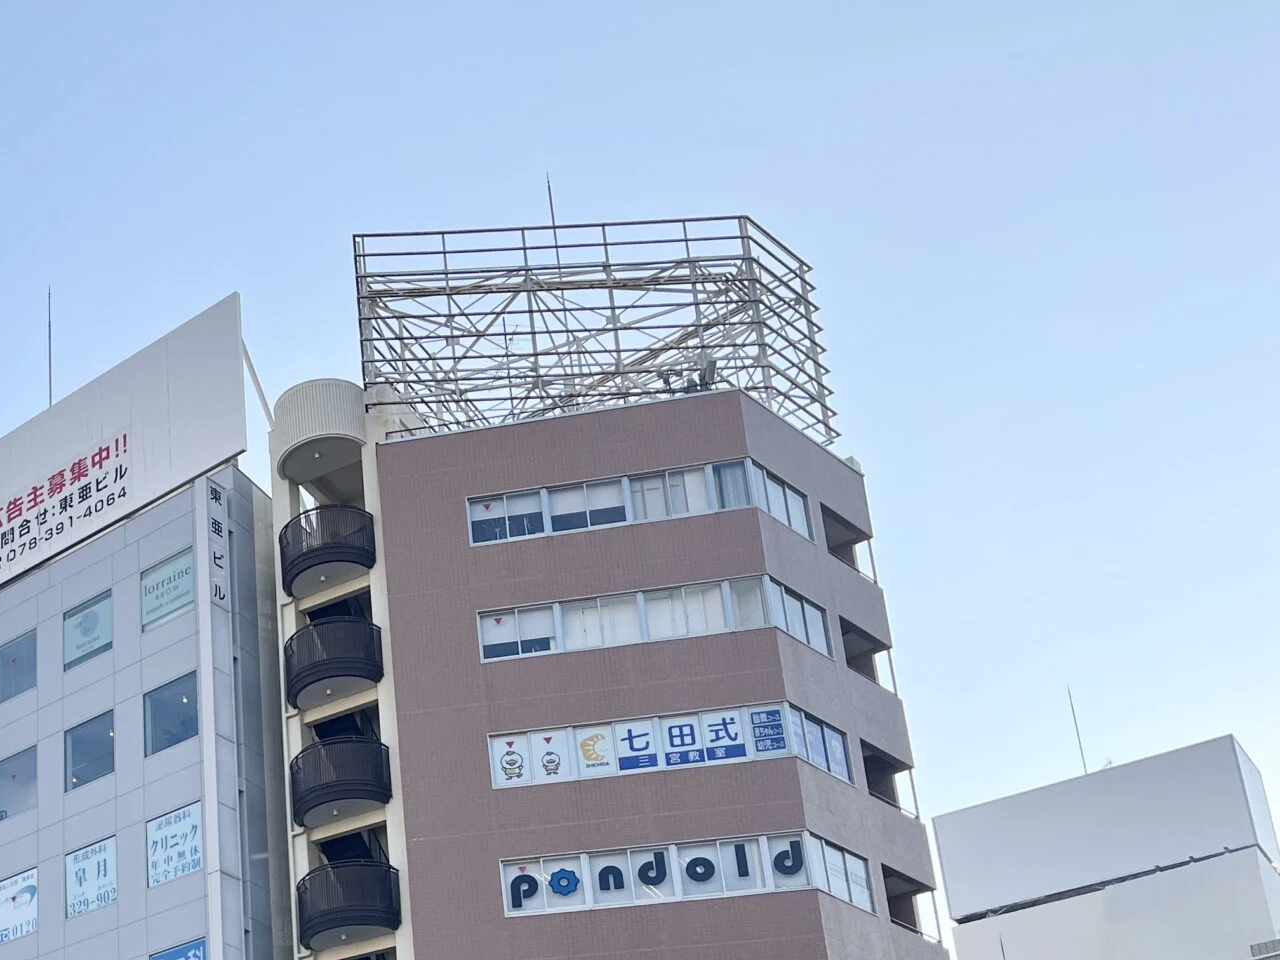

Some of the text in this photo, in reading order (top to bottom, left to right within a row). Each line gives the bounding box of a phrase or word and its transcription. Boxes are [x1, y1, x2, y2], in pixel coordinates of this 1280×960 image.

[6, 486, 128, 564] 078-391-4064
[209, 485, 226, 601] 東亜ビル
[144, 565, 192, 597] lorraine
[621, 716, 738, 753] 七田式
[150, 824, 198, 857] クリニック
